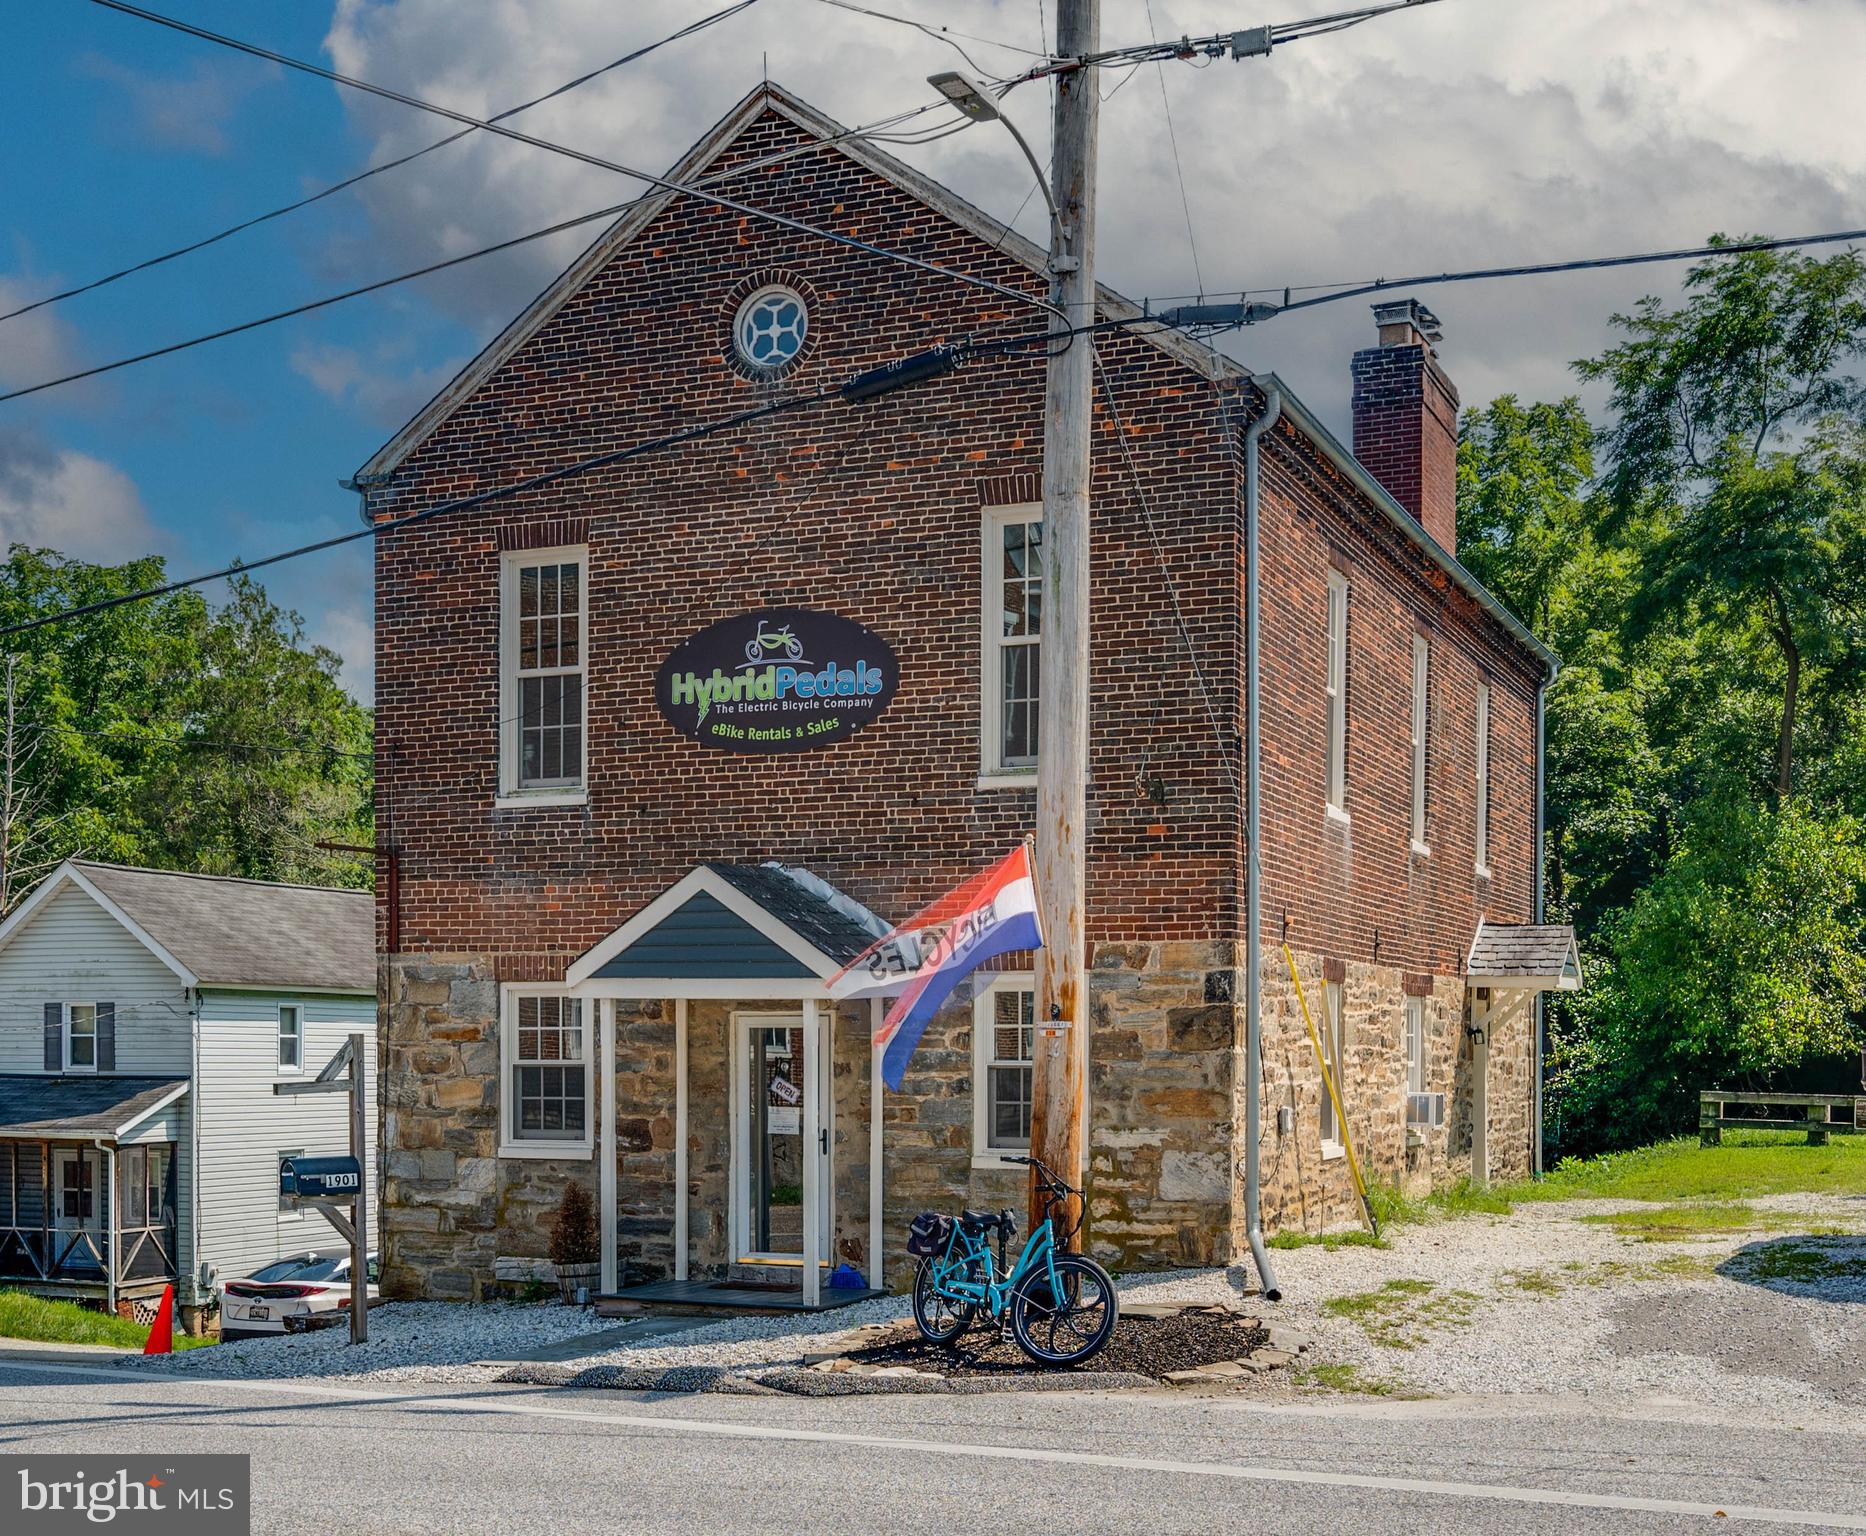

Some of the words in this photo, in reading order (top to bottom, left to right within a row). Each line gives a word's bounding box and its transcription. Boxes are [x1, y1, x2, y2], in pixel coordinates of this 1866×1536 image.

[715, 704, 734, 714] The
[738, 701, 778, 713] Electric
[782, 699, 820, 712] Bicycle
[823, 698, 874, 710] Company
[711, 723, 744, 739] eBike
[748, 727, 792, 740] Rentals
[796, 727, 804, 737] &
[807, 716, 840, 735] Sales
[776, 1081, 796, 1099] OPEN
[327, 1174, 356, 1187] 1901
